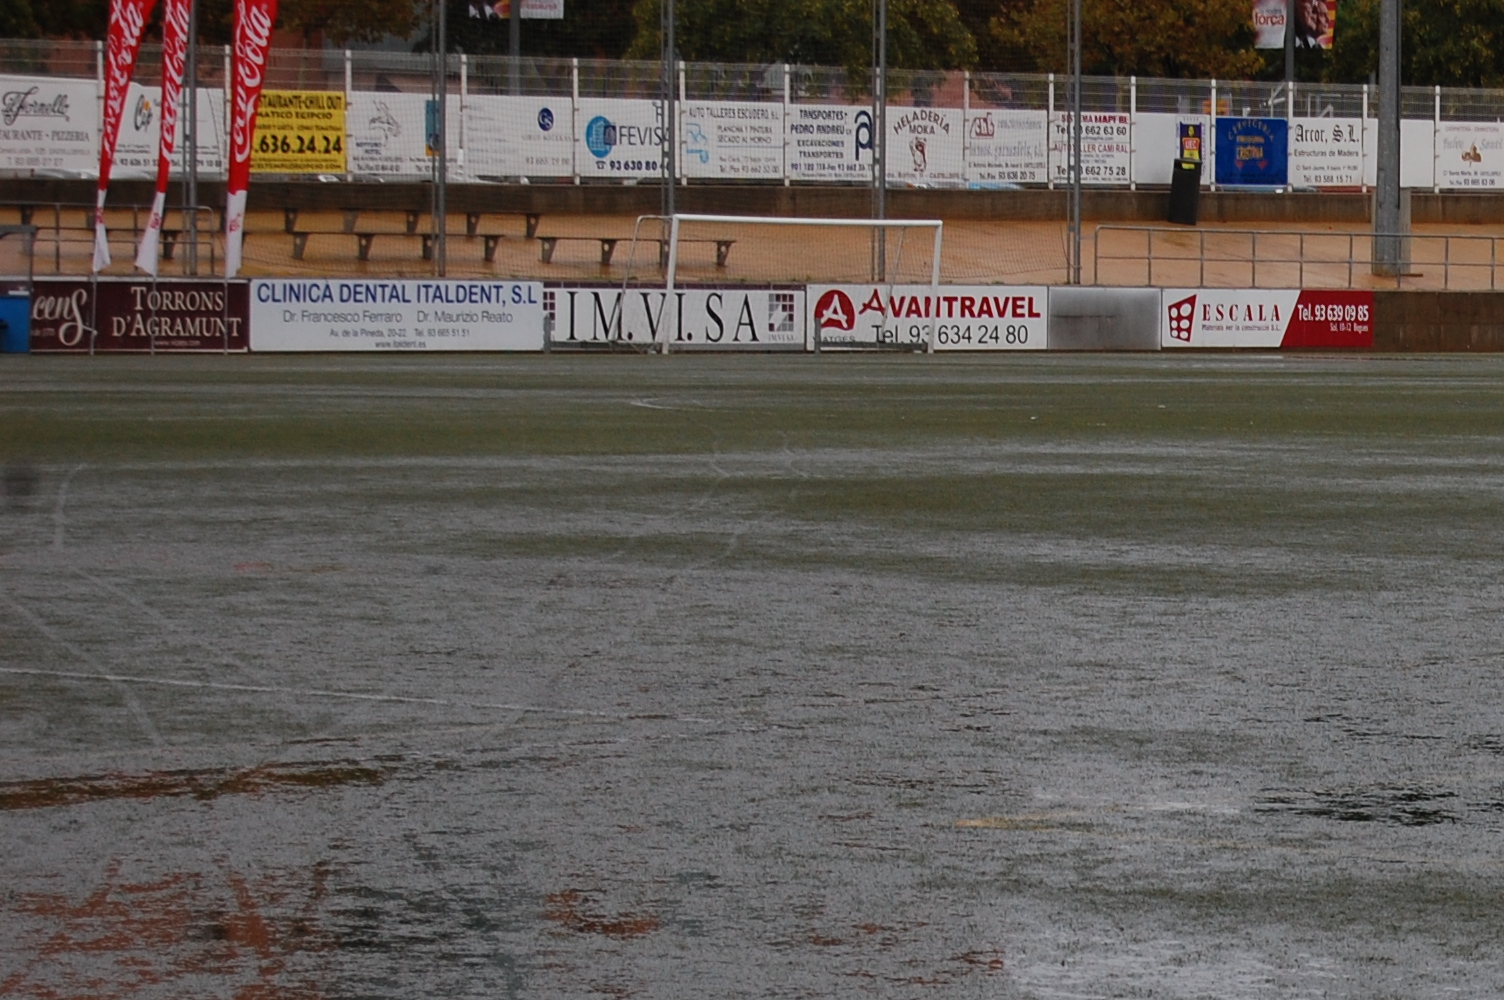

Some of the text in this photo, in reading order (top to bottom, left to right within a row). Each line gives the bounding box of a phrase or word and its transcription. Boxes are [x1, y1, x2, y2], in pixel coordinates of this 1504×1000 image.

[689, 108, 736, 120] AUTO TALLERES
[717, 126, 743, 134] PLANCHA
[750, 126, 773, 134] PINTURA
[790, 123, 845, 136] PEDRO ANDREU
[908, 124, 936, 136] MOKA
[1085, 126, 1127, 137] 662 63 60
[1332, 124, 1360, 143] S.L.
[750, 136, 772, 144] HORNO
[797, 139, 845, 148] EXCAVACIONES
[1115, 144, 1128, 154] RAL
[1293, 149, 1360, 158] Estructuras de Madera
[799, 151, 844, 159] TRANSPORTES
[609, 160, 622, 170] 93
[624, 160, 643, 170] 630
[645, 160, 657, 170] 80
[1085, 166, 1127, 176] 662 75 28
[130, 286, 225, 312] TORRONS
[257, 282, 538, 308] CLINICA DENTAL ITALDENT, S.L
[858, 288, 1042, 319] AVANTRAVEL
[283, 310, 514, 324] Dr. Francesco Ferraro Dr. Maurizio Reato
[1201, 303, 1282, 322] ESCALA
[1297, 303, 1370, 322] Tel. 93 639 09 85
[341, 328, 351, 338] de
[352, 328, 359, 338] la
[360, 328, 386, 339] Pineda,
[414, 329, 426, 338] Tel.
[427, 329, 437, 338] 93
[451, 329, 461, 338] 51
[462, 329, 470, 338] 51
[871, 324, 1029, 345] Tel. 93 634 24 80
[374, 339, 427, 349] www.italdent.es
